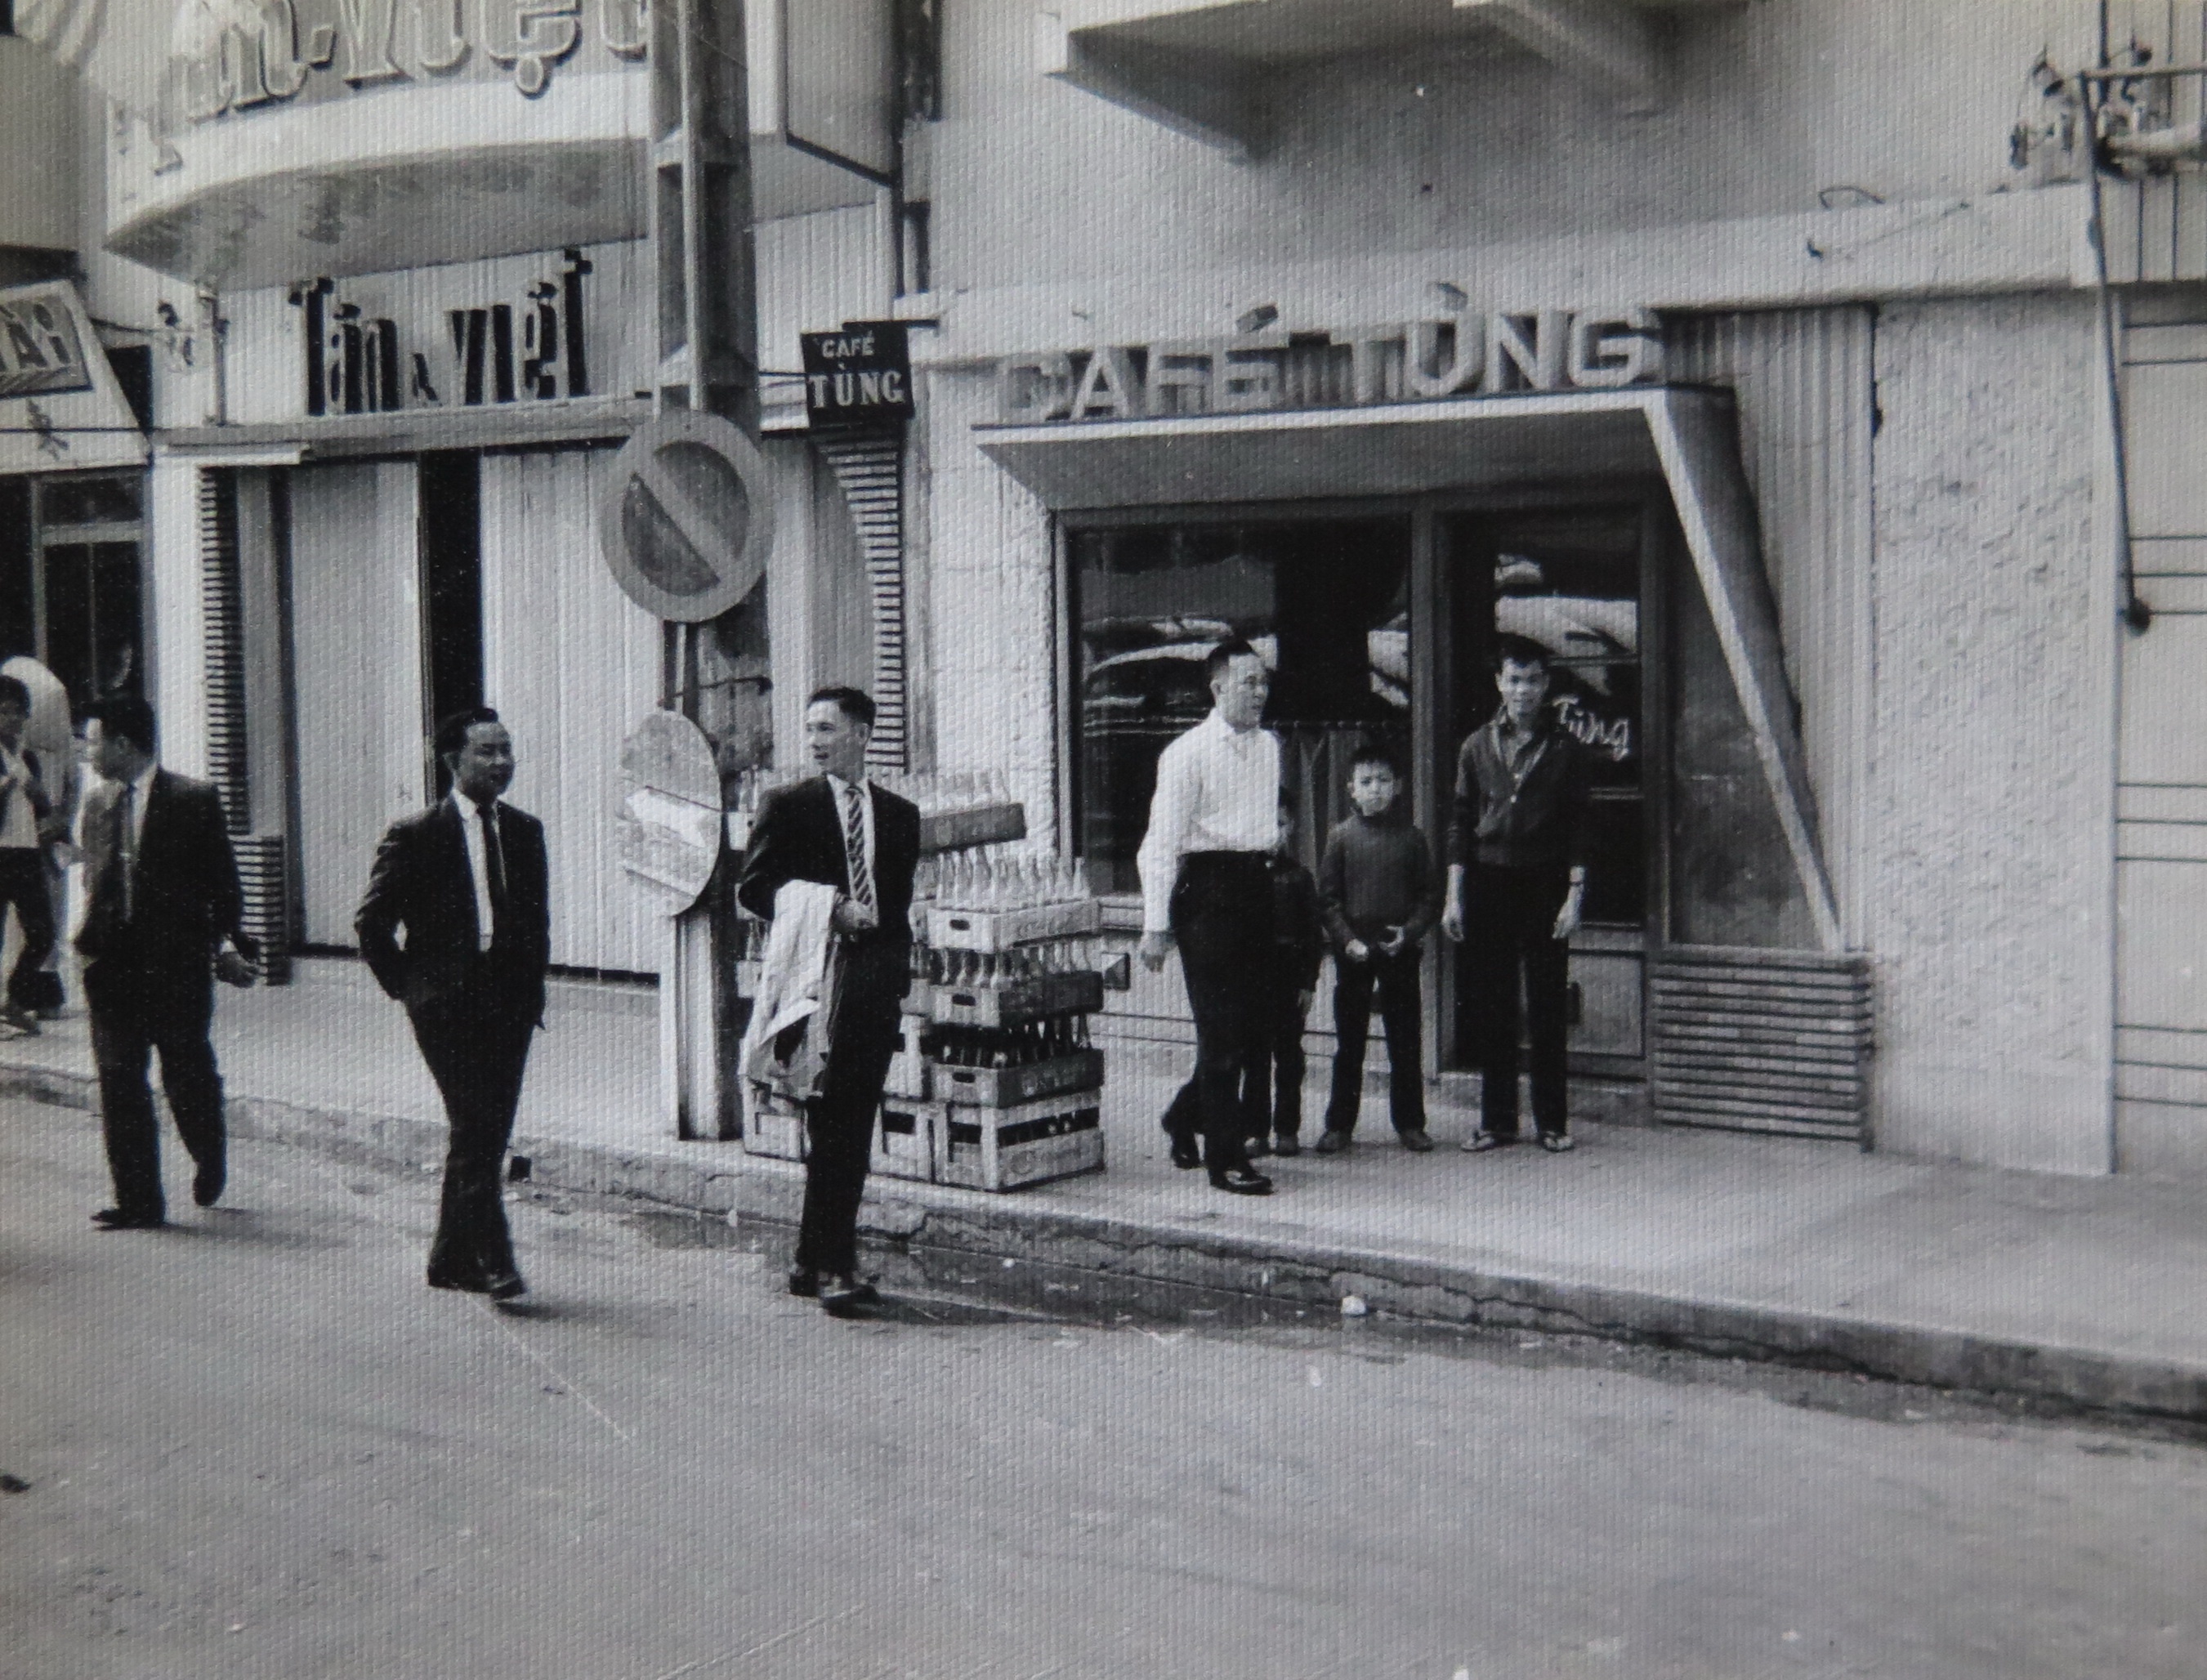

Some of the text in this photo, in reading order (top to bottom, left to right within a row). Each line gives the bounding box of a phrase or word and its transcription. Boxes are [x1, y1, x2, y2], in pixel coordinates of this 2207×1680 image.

[820, 329, 875, 359] CAFÉ
[997, 280, 1651, 423] CAFÉ TÙNG
[808, 362, 905, 409] TÙNG
